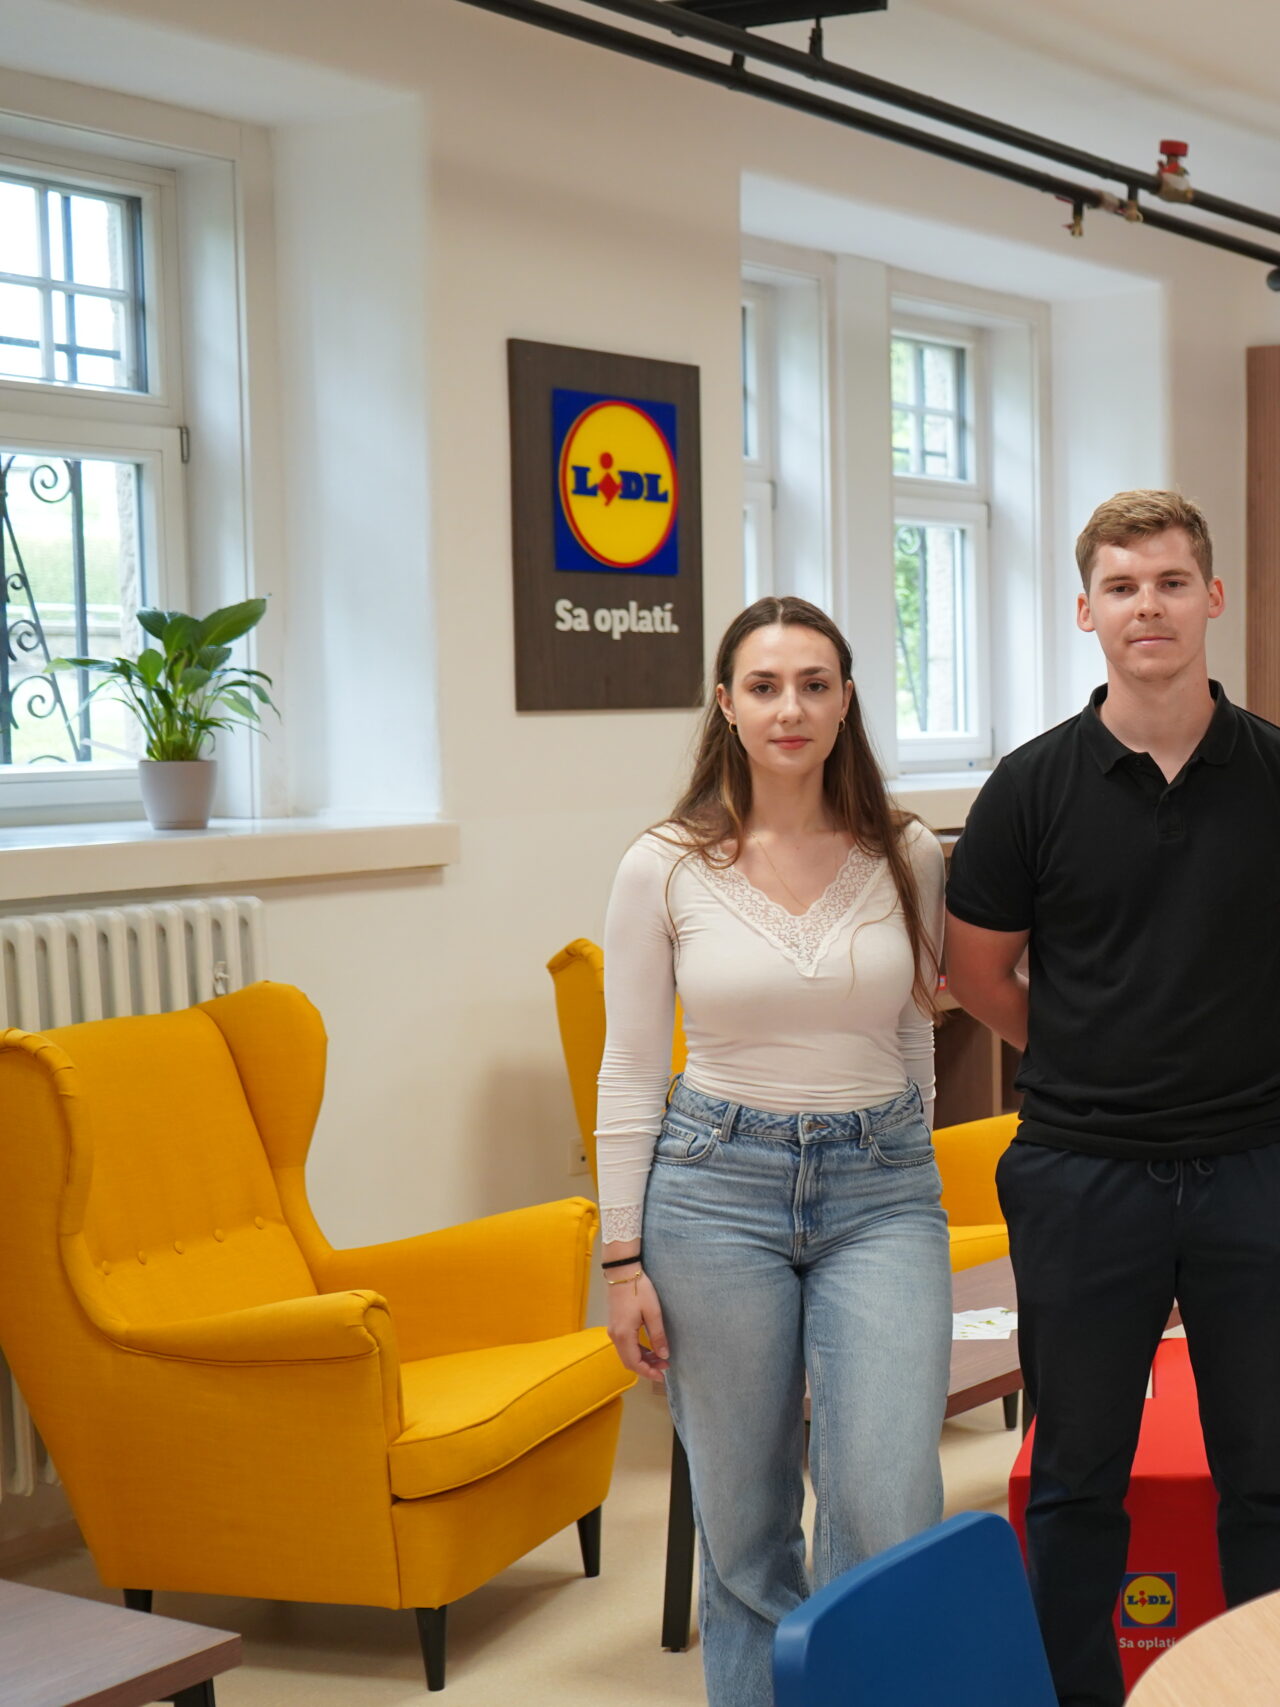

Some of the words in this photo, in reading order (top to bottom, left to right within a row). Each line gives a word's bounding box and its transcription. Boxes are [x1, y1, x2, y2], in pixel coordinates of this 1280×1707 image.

[555, 598, 590, 632] Sa
[594, 601, 679, 640] oplatí.
[1119, 1637, 1135, 1648] Sa
